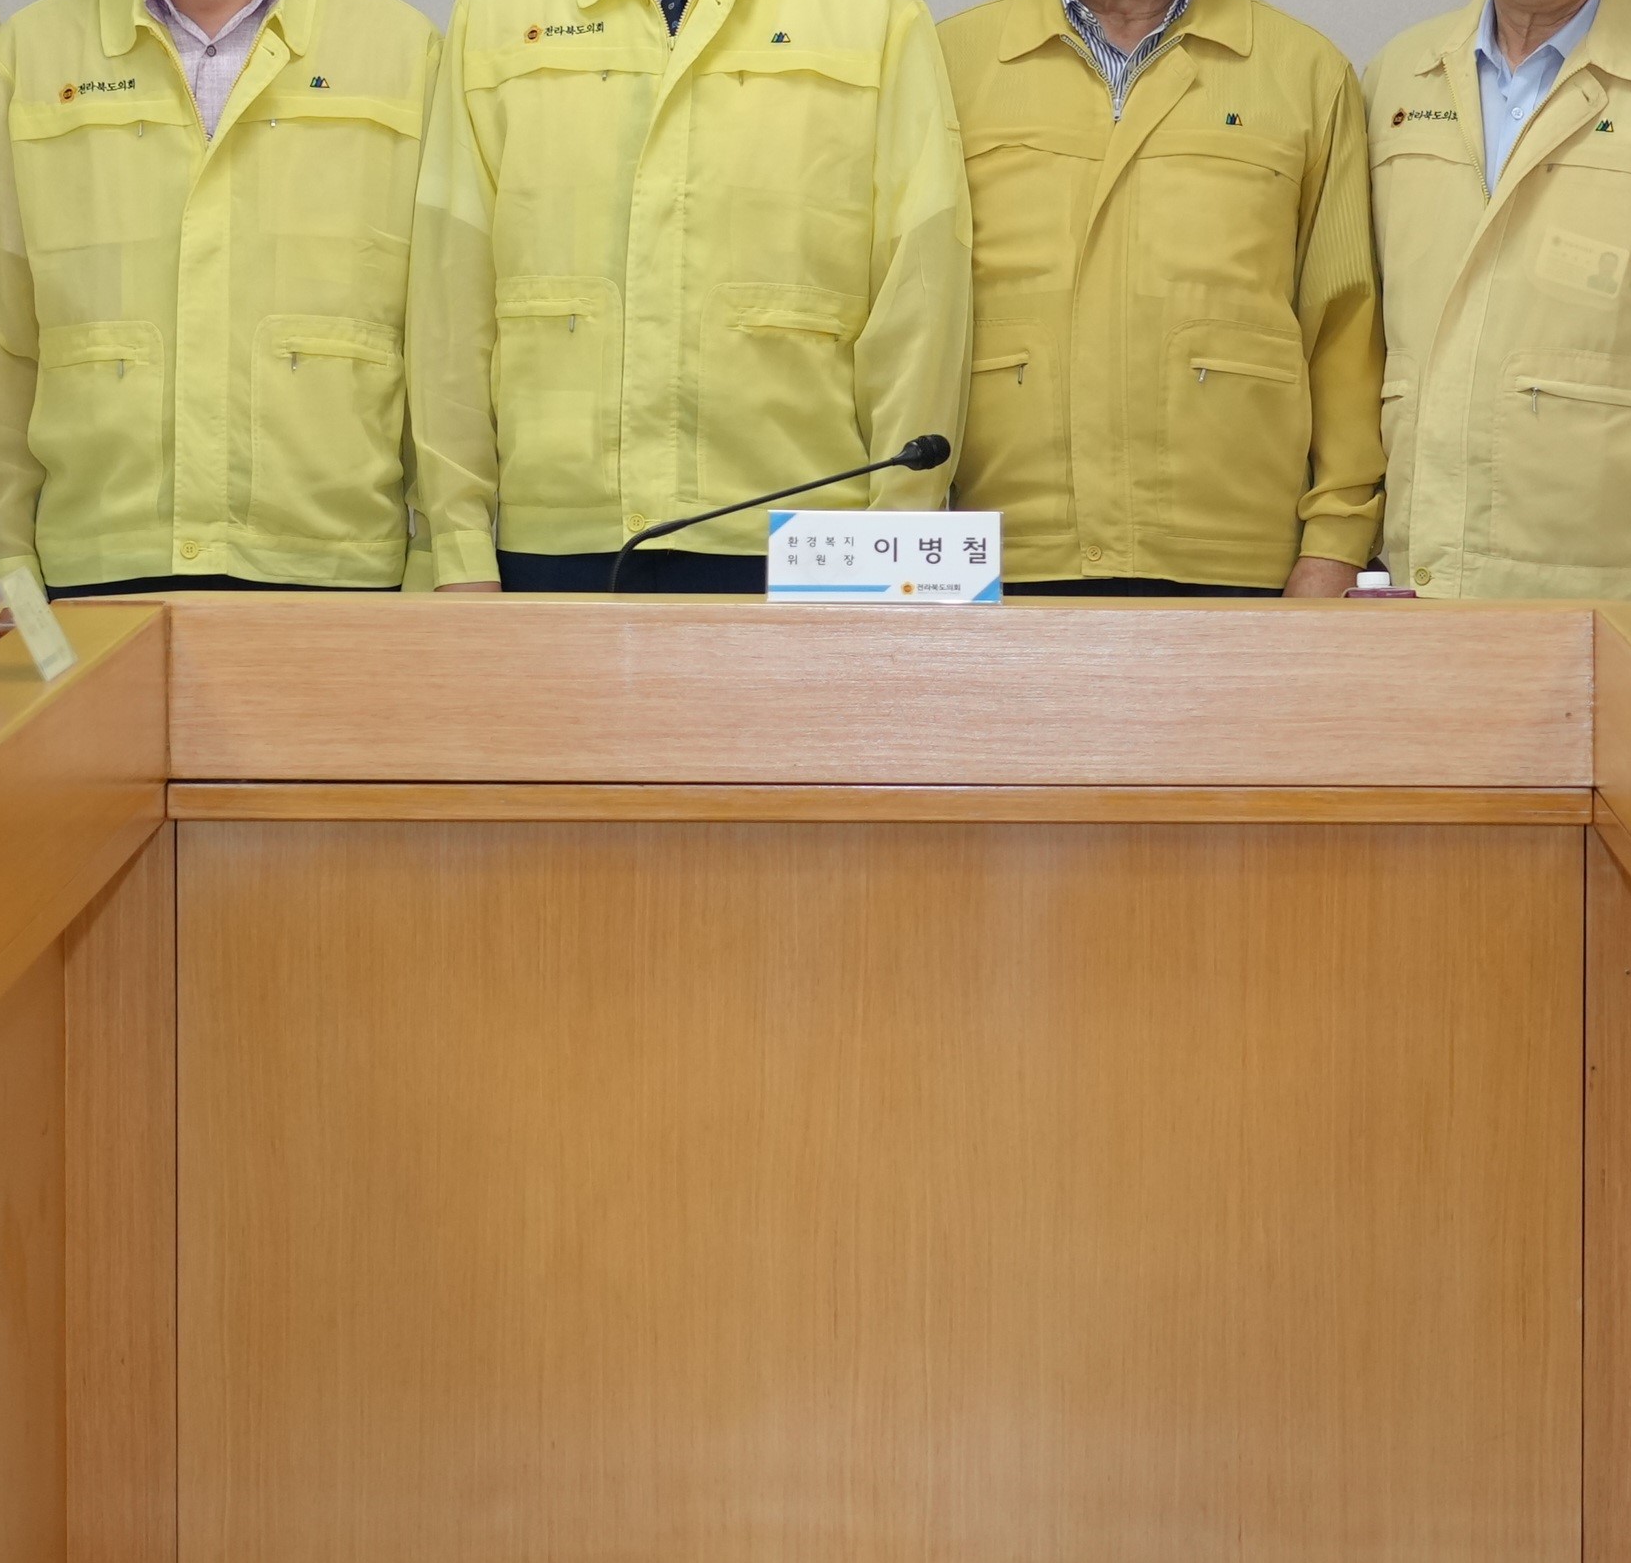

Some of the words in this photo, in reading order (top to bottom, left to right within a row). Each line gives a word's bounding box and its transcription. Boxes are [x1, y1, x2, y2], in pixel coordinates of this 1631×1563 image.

[544, 21, 604, 36] 전라북도의회
[77, 78, 136, 95] 전라북도의회
[873, 537, 987, 565] 이병철
